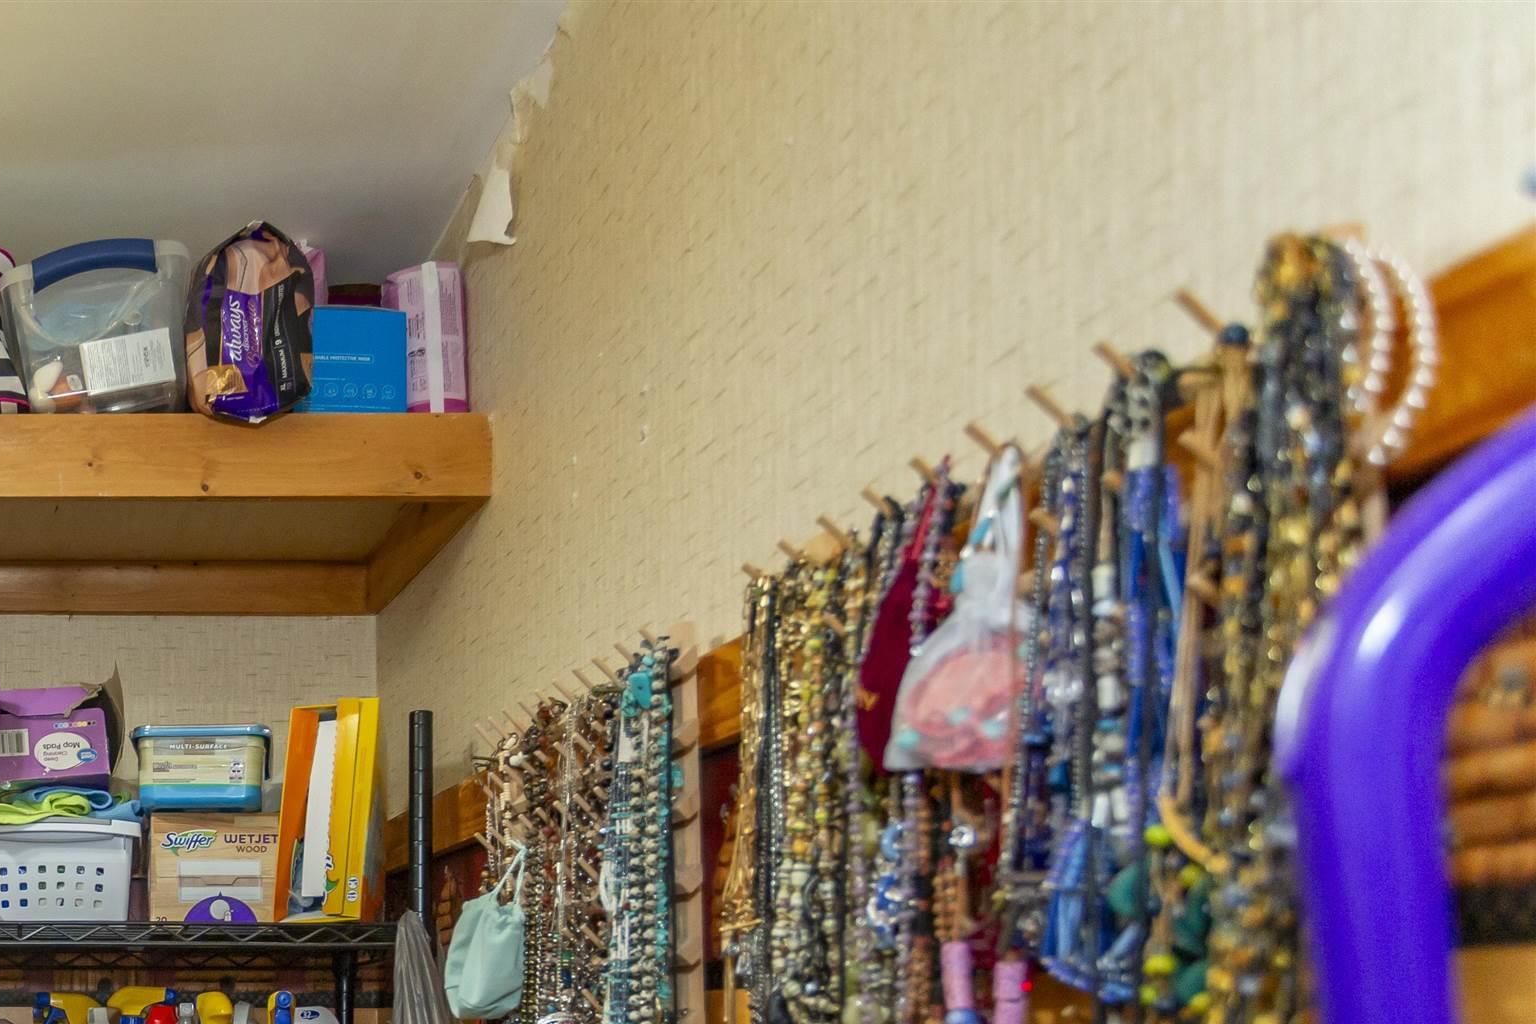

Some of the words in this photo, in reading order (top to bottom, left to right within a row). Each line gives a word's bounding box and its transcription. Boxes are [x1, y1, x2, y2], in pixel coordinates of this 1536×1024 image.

[226, 295, 247, 362] always
[63, 741, 81, 749] Mop
[162, 832, 214, 850] Swiffer
[224, 834, 278, 844] WETJET
